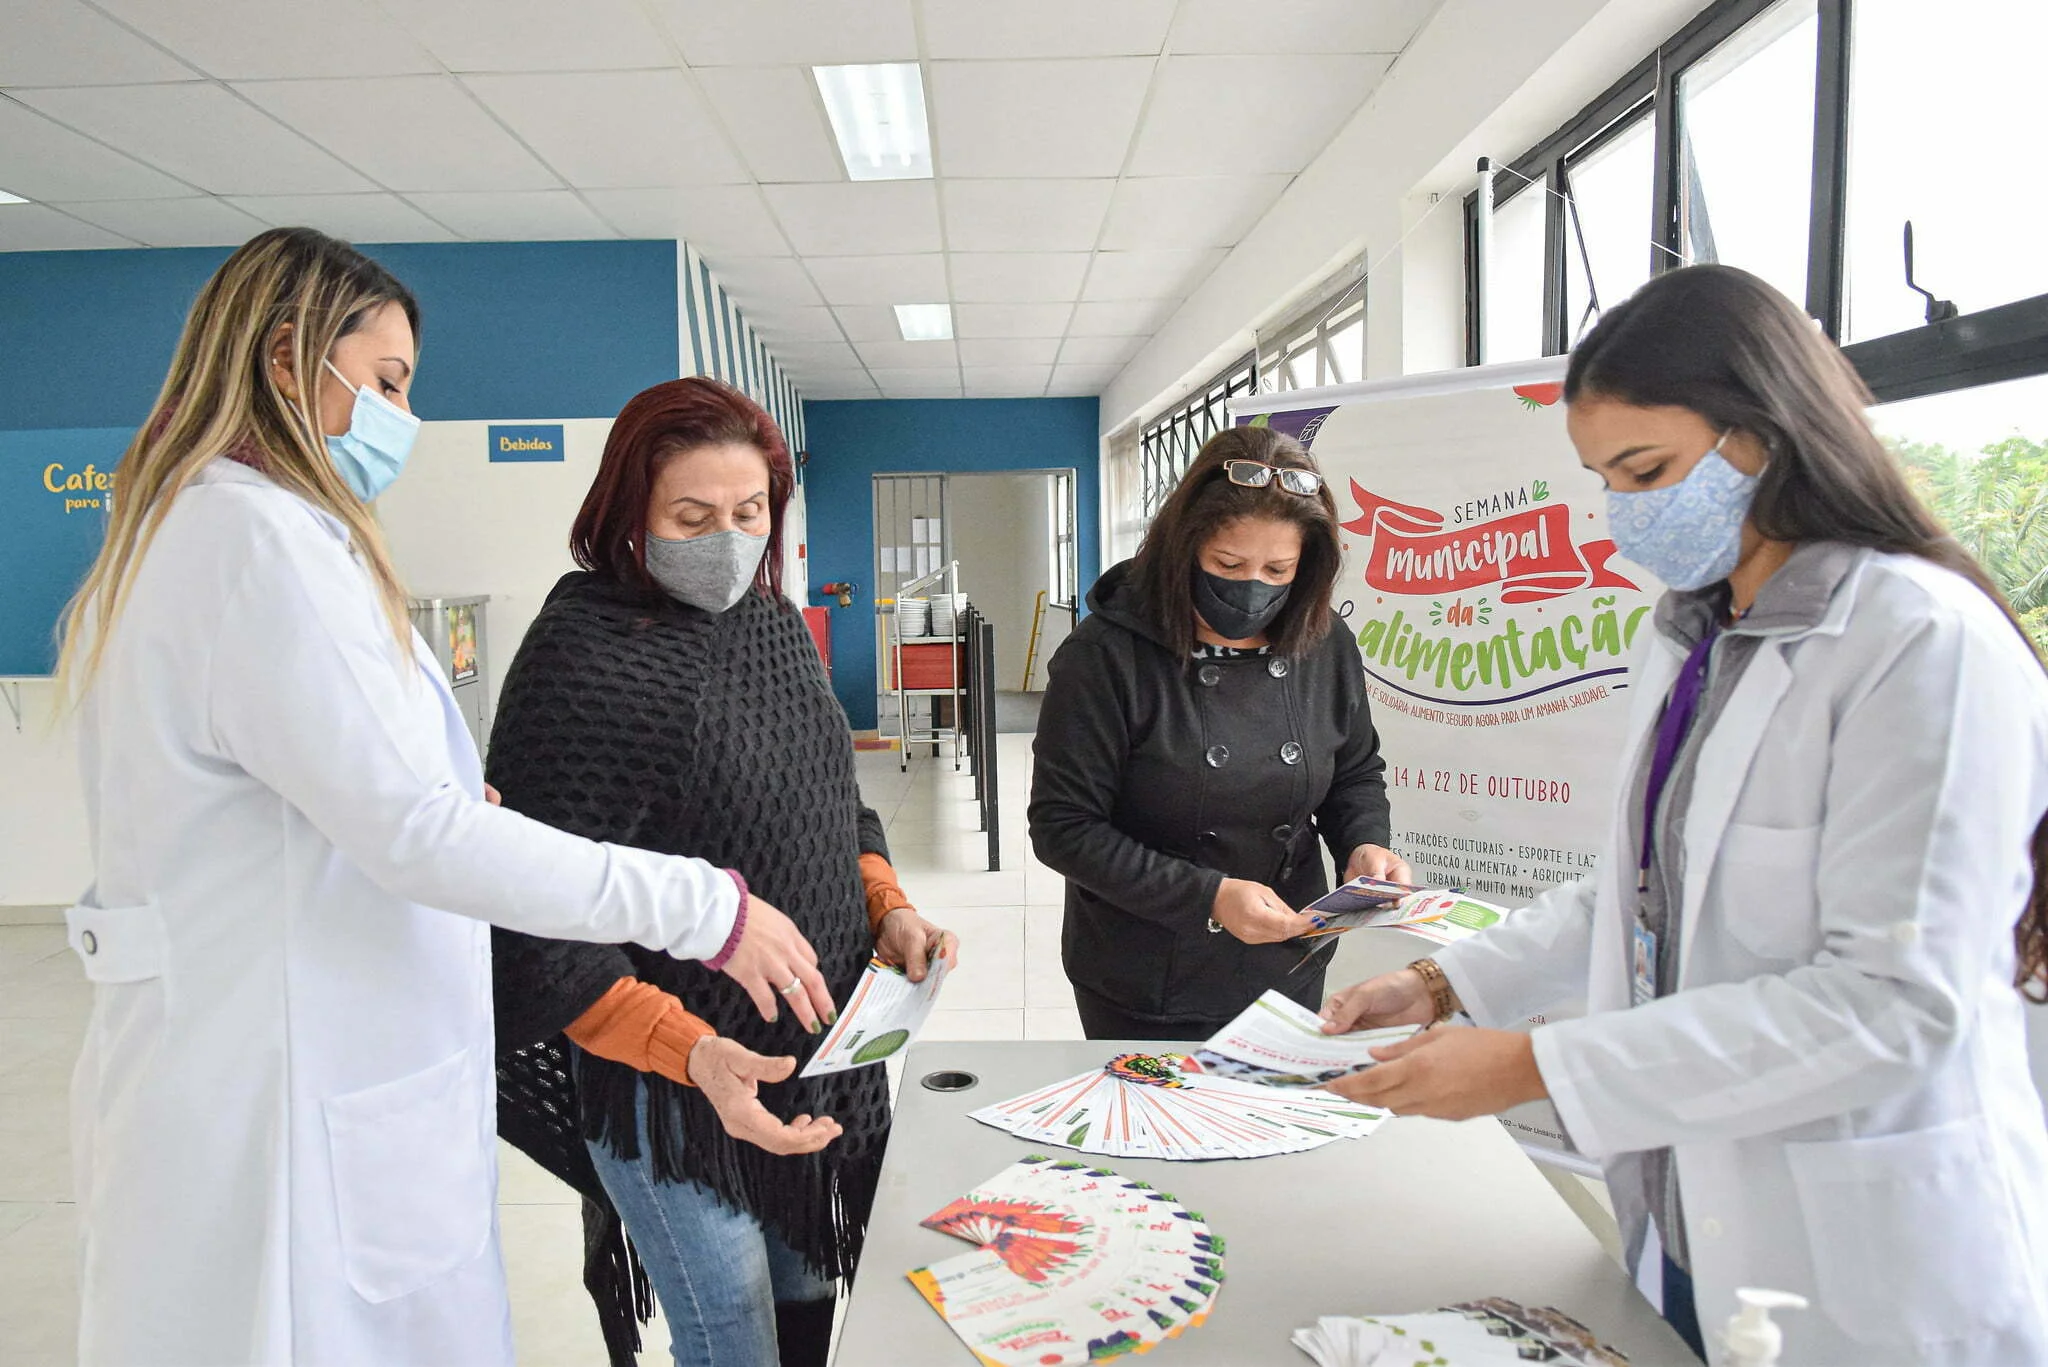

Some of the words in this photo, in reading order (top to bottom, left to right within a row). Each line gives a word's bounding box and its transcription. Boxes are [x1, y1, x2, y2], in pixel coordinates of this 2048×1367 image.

[500, 436, 553, 451] Bebidas
[65, 498, 100, 514] para
[1454, 487, 1528, 524] SEMANA
[1447, 598, 1474, 627] da
[1411, 704, 1444, 724] ALIMENTO
[1446, 712, 1473, 727] SEGURO
[1475, 713, 1500, 727] AGORA
[1501, 710, 1520, 725] PARA
[1522, 708, 1535, 720] UM
[1394, 766, 1409, 788] 14
[1417, 769, 1426, 790] A
[1434, 771, 1451, 792] 22
[1460, 773, 1479, 795] DE
[1488, 776, 1571, 804] OUTUBRO
[1405, 831, 1448, 849] ATRAÇÕES
[1453, 838, 1504, 856] CULTURAIS
[1519, 845, 1562, 863] ESPORTE
[1568, 852, 1573, 865] E
[1415, 851, 1460, 869] EDUCAÇÃO
[1464, 859, 1518, 877] ALIMENTAR
[1426, 871, 1461, 888] URBANA
[1476, 879, 1506, 894] MUITO
[1511, 883, 1535, 899] MAIS
